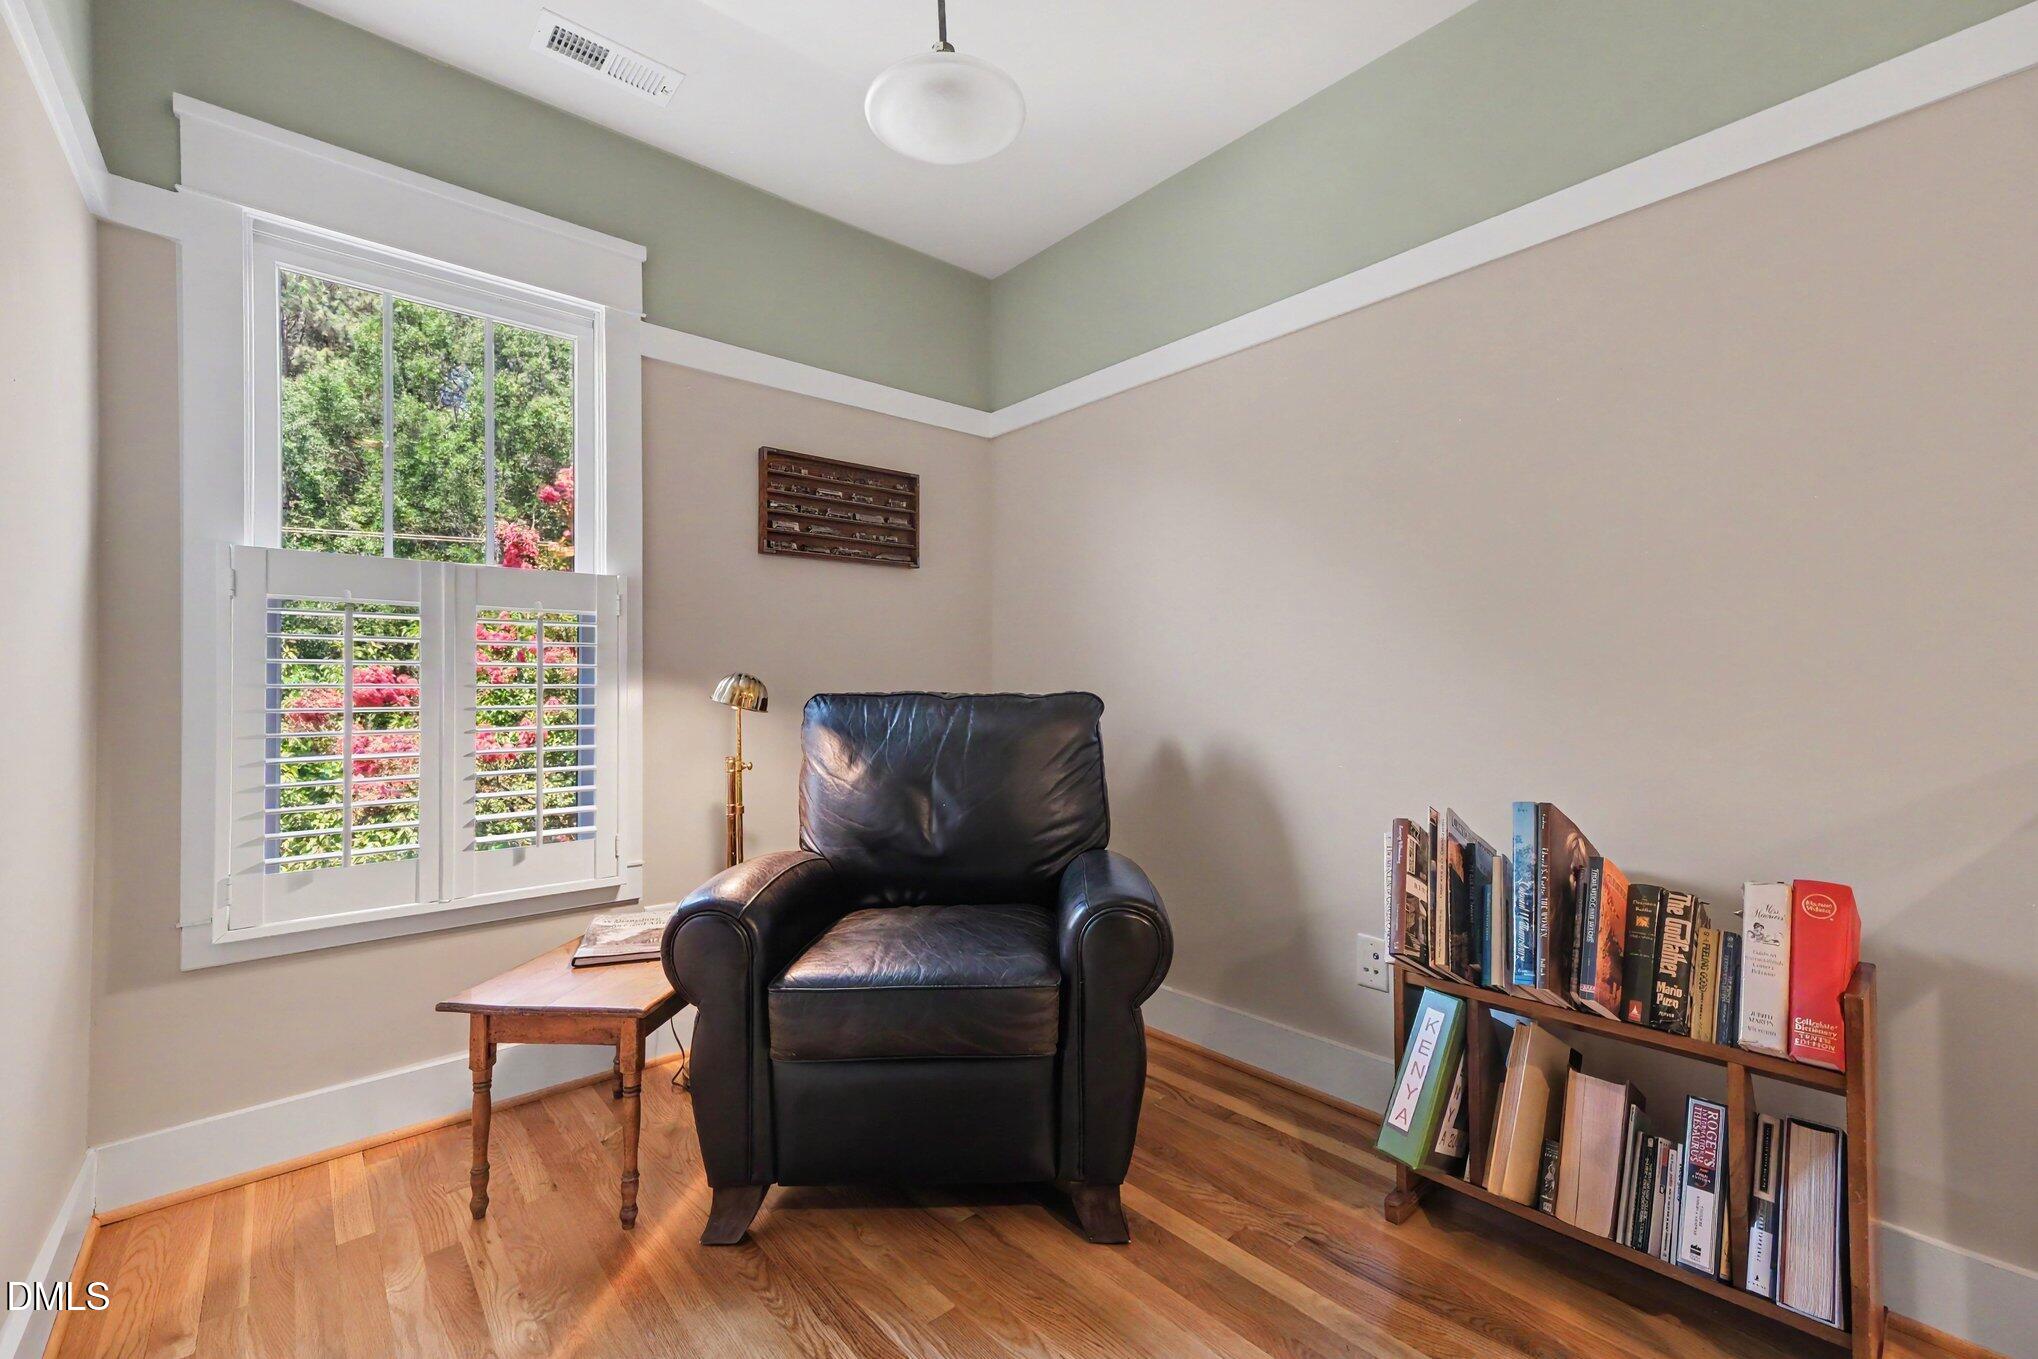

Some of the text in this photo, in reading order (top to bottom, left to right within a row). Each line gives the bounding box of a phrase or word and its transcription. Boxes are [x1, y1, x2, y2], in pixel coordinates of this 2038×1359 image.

[1666, 892, 1692, 916] The
[1659, 916, 1692, 978] Godfather
[1656, 980, 1683, 998] Mario
[1698, 971, 1709, 994] GOOD
[1394, 1017, 1441, 1127] KENYA
[1689, 1106, 1702, 1163] THESAURUS
[1703, 1109, 1719, 1169] ROGET'S
